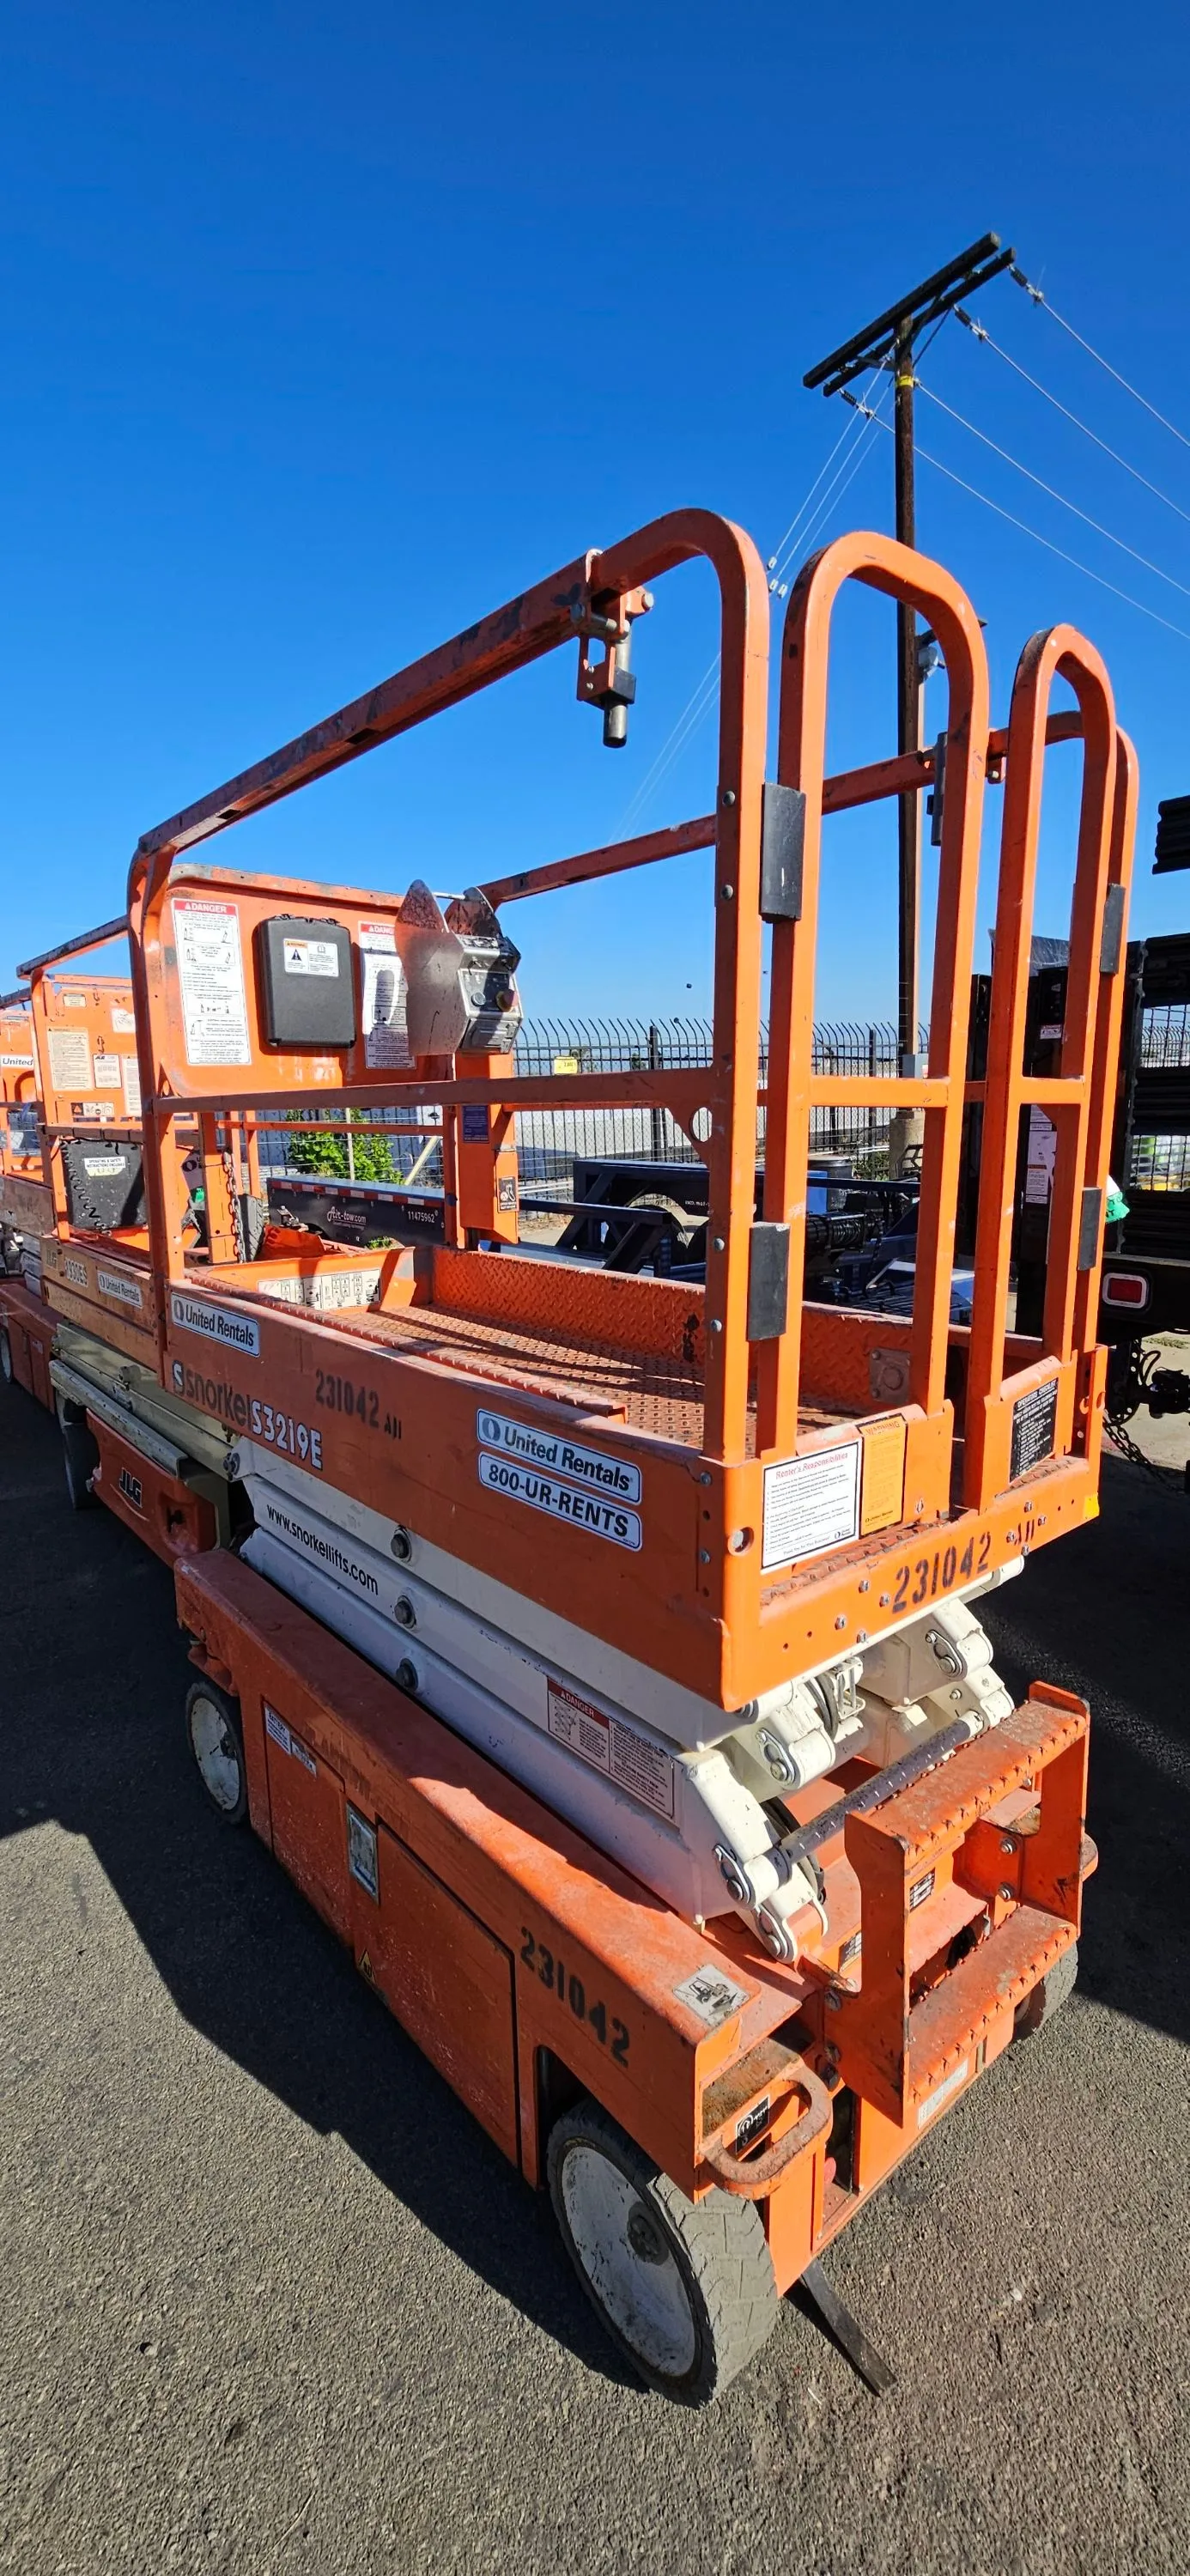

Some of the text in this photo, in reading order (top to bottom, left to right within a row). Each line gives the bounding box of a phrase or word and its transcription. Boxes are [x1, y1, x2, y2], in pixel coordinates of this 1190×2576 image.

[191, 903, 227, 914] DANGER
[2, 1057, 33, 1066] United
[105, 1275, 120, 1294] United
[185, 1304, 254, 1346] United Rentals
[185, 1369, 252, 1431] snorkel
[252, 1399, 323, 1471] S3219E
[315, 1367, 379, 1430] 231042
[118, 1467, 143, 1508] JLG
[504, 1425, 630, 1492] United Rentals
[489, 1463, 628, 1538] 800-UR-RENTS
[266, 1504, 379, 1595] www.snorkellifts.com
[892, 1530, 992, 1614] 231042
[565, 1693, 594, 1717] DANGER
[519, 1926, 630, 2069] 231042
